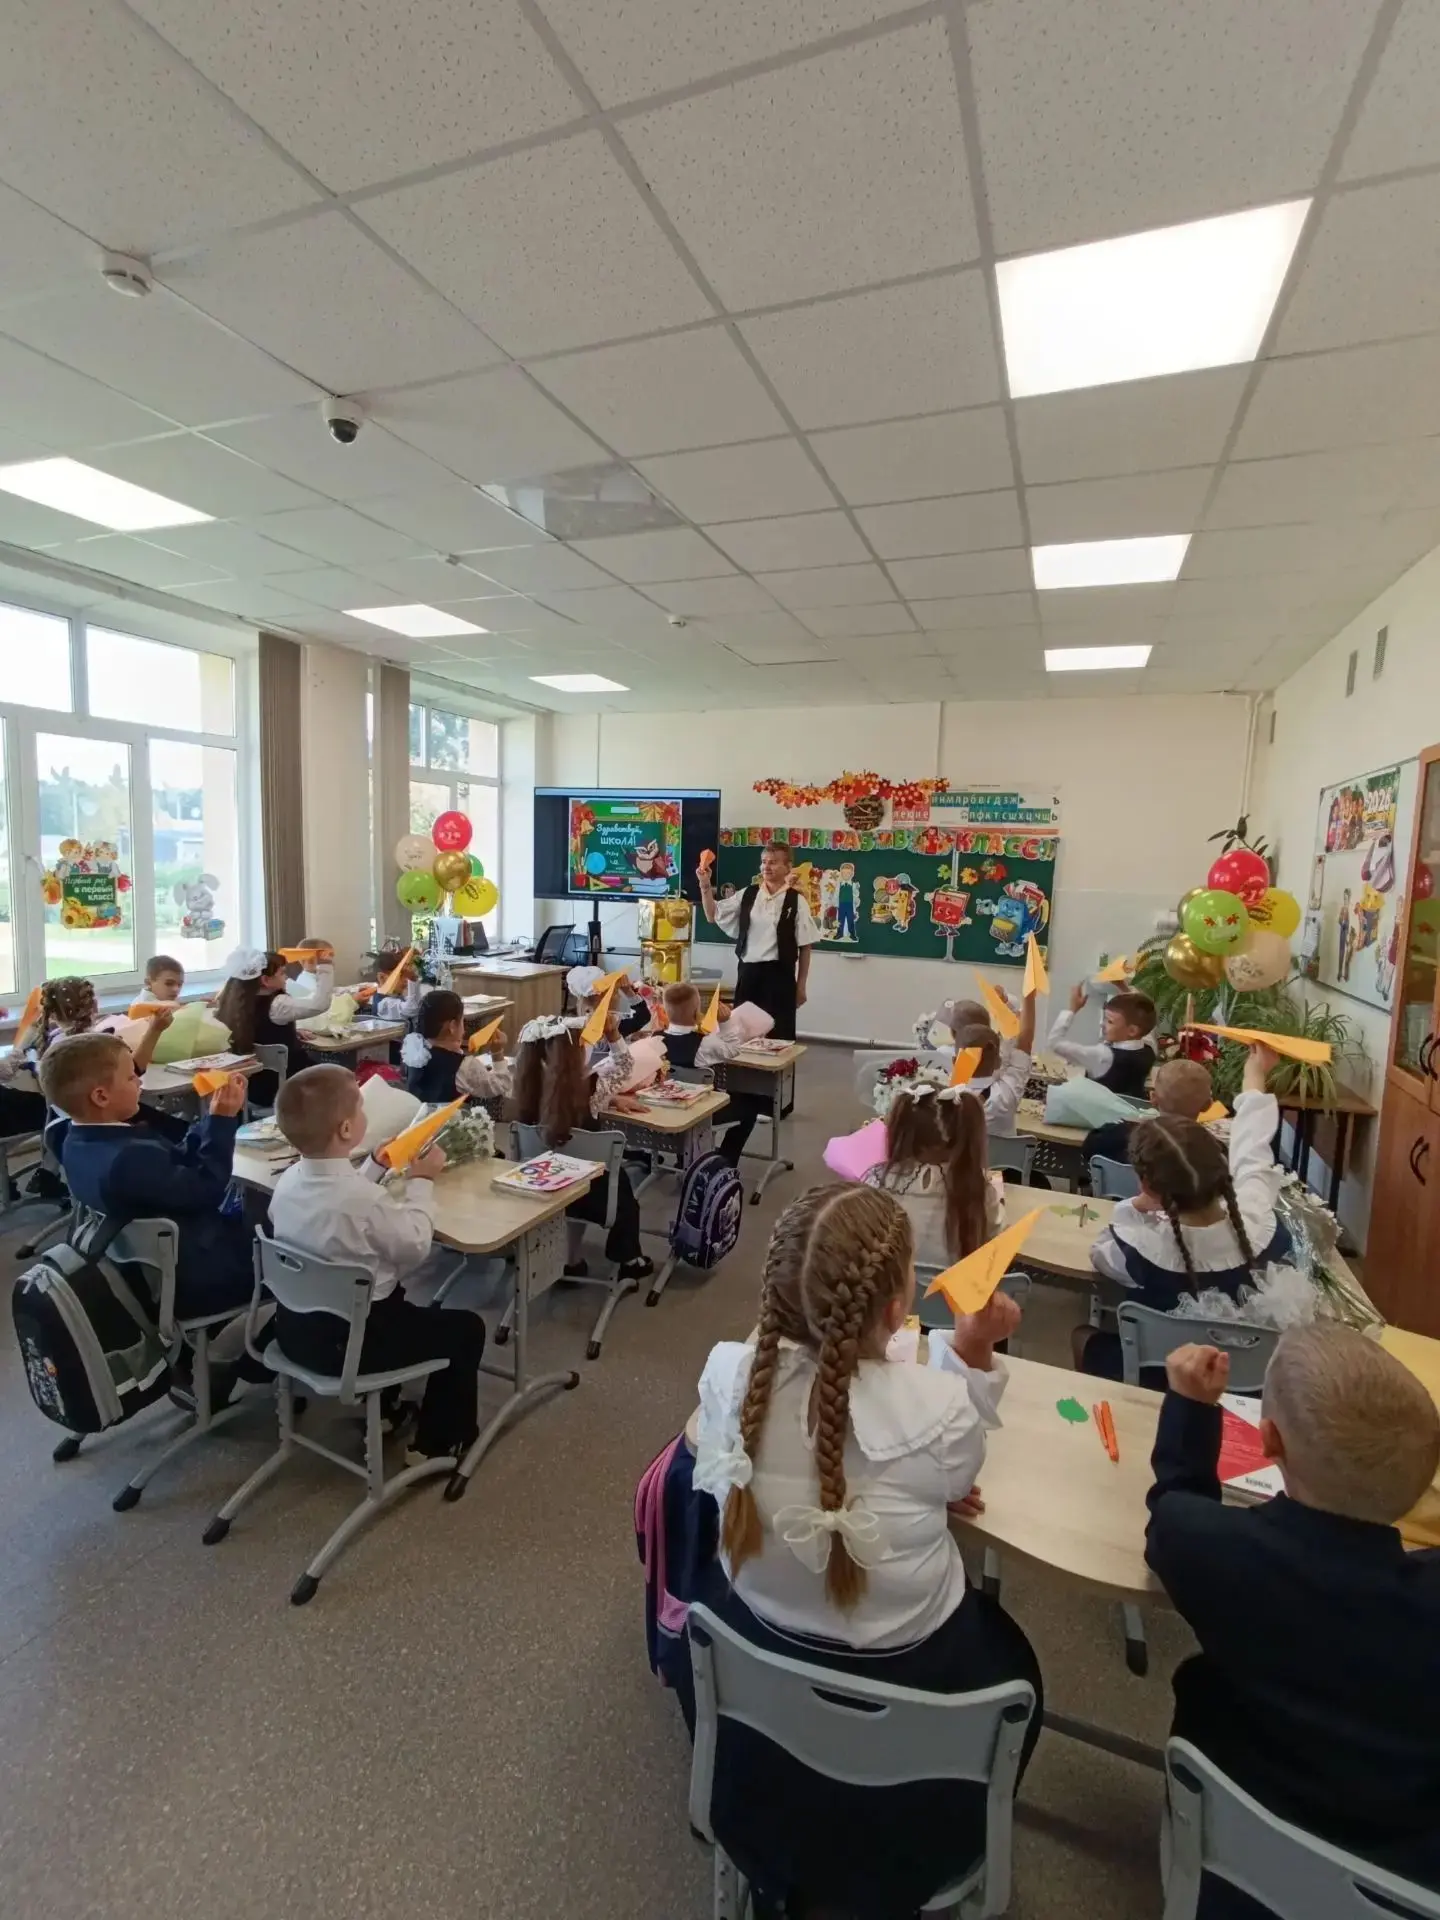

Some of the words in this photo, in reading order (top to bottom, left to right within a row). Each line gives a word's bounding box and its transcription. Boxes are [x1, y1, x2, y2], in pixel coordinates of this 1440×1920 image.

[733, 827, 826, 848] ПЕРВЫЙ
[831, 829, 875, 850] РАЗ
[893, 829, 908, 849] В
[956, 831, 1056, 861] КЛАСС!
